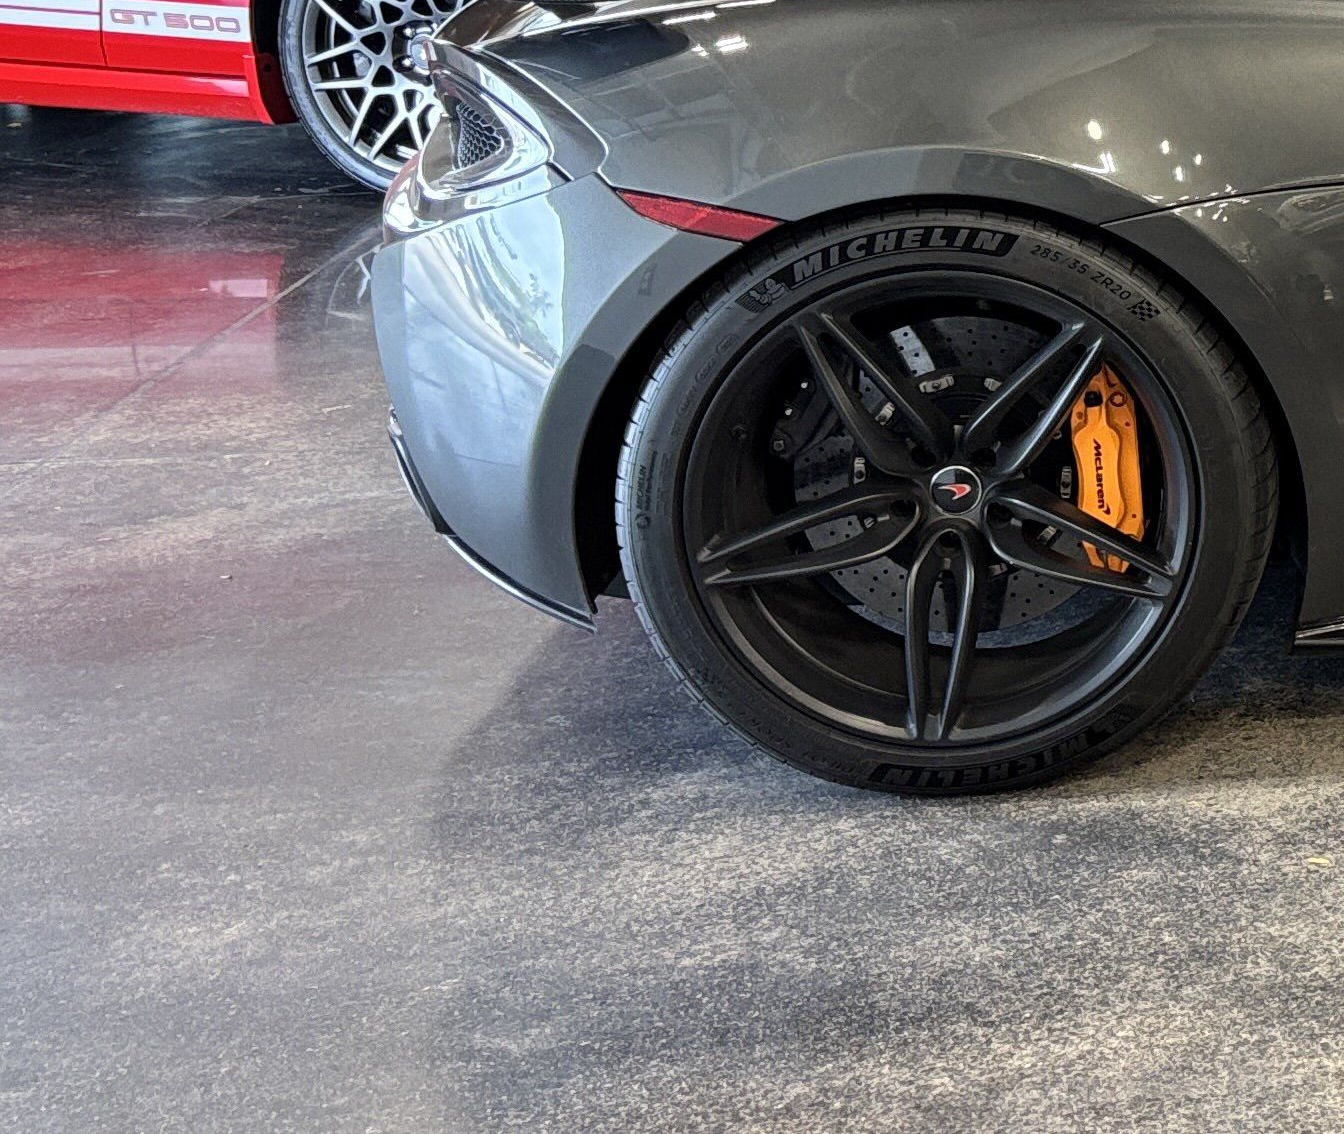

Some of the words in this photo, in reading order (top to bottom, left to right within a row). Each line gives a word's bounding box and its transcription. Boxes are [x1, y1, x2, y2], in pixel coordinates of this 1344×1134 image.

[110, 9, 157, 26] GT
[163, 12, 241, 33] 500
[792, 227, 1004, 283] MICHELIN
[1030, 244, 1090, 274] 285/35
[1091, 271, 1132, 300] ZR20
[1093, 438, 1106, 510] McLaren
